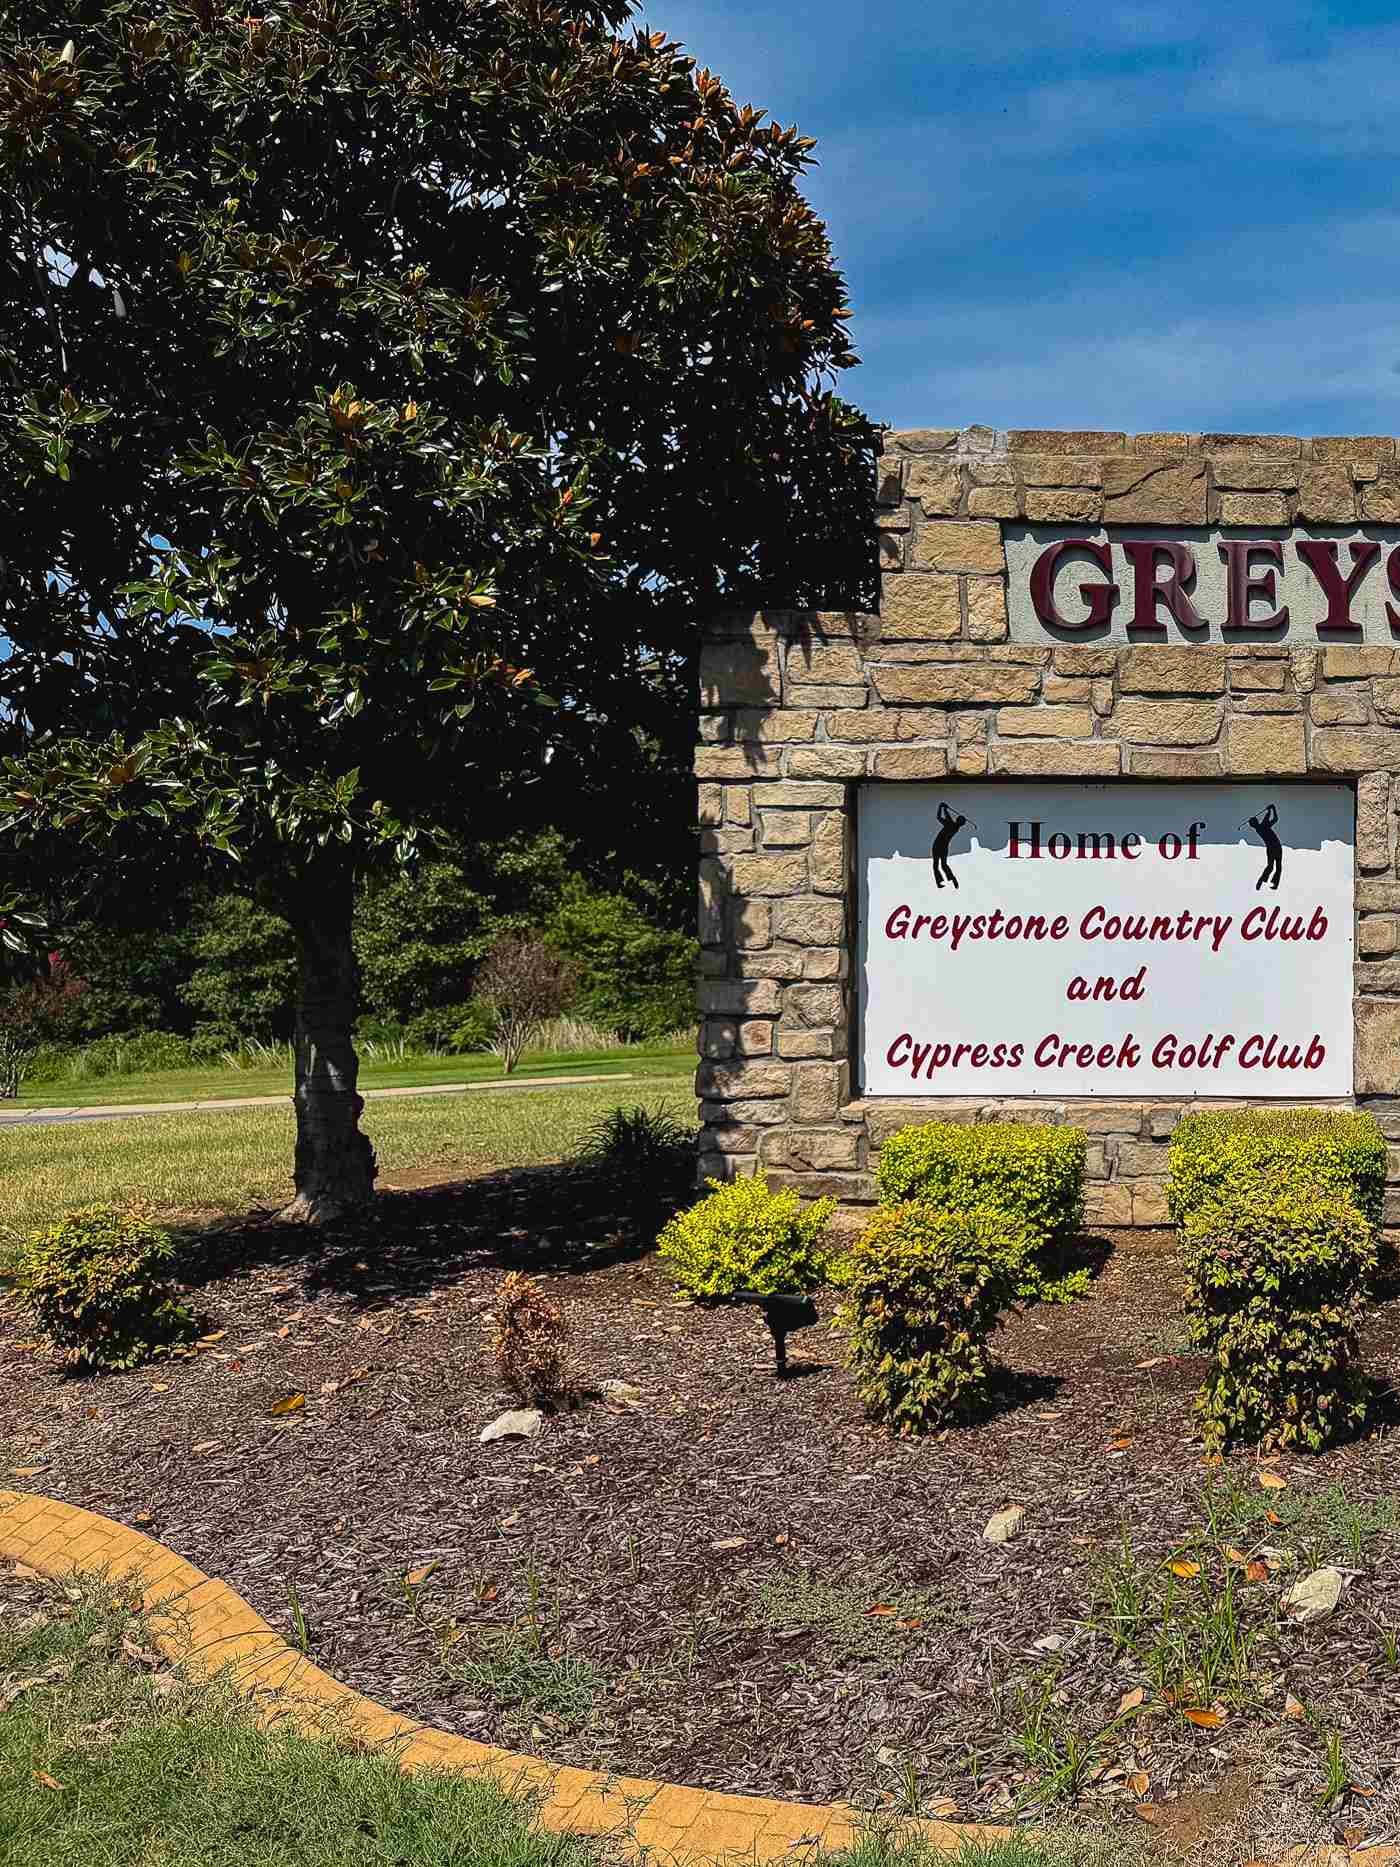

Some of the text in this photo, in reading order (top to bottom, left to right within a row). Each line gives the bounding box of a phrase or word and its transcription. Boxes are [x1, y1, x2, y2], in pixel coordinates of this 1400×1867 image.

[1006, 820, 1206, 861] Home of
[884, 904, 1329, 952] Greystone Country Club
[1066, 965, 1148, 1002] and
[886, 1033, 1326, 1080] Cypress Creek Golf Club
